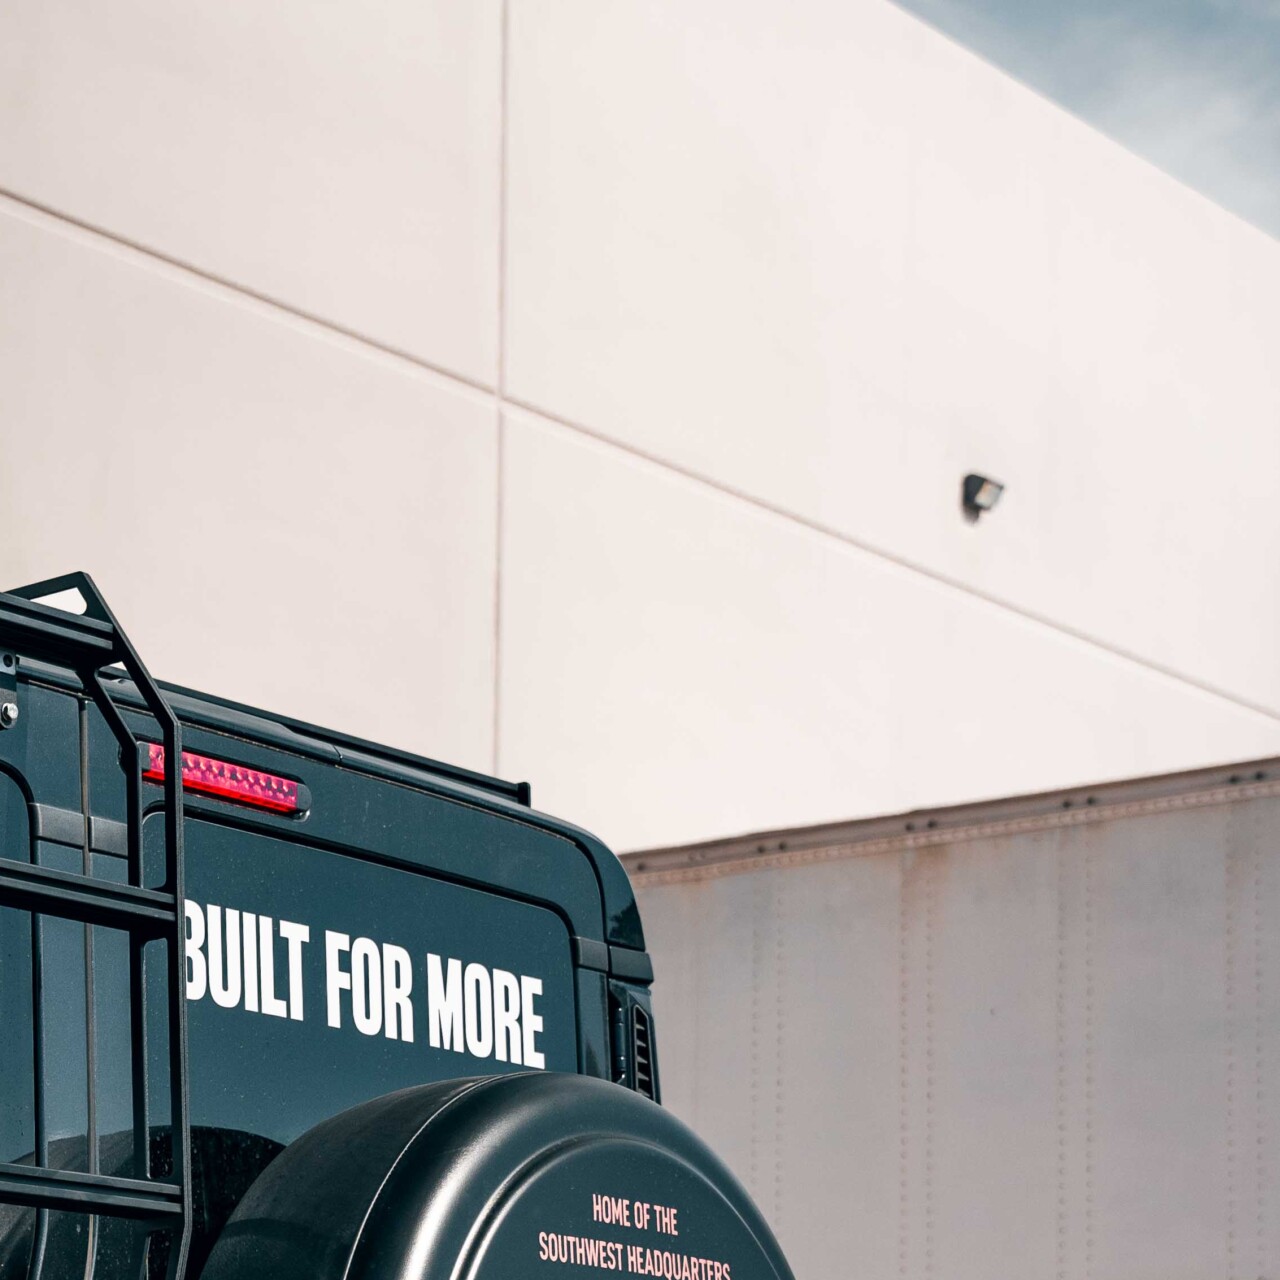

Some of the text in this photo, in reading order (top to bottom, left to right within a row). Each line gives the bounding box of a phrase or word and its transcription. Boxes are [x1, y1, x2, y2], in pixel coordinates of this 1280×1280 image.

[184, 898, 545, 1070] BUILT FOR MORE
[592, 1193, 679, 1236] HOME OF THE
[538, 1231, 624, 1272] SOUTHWEST
